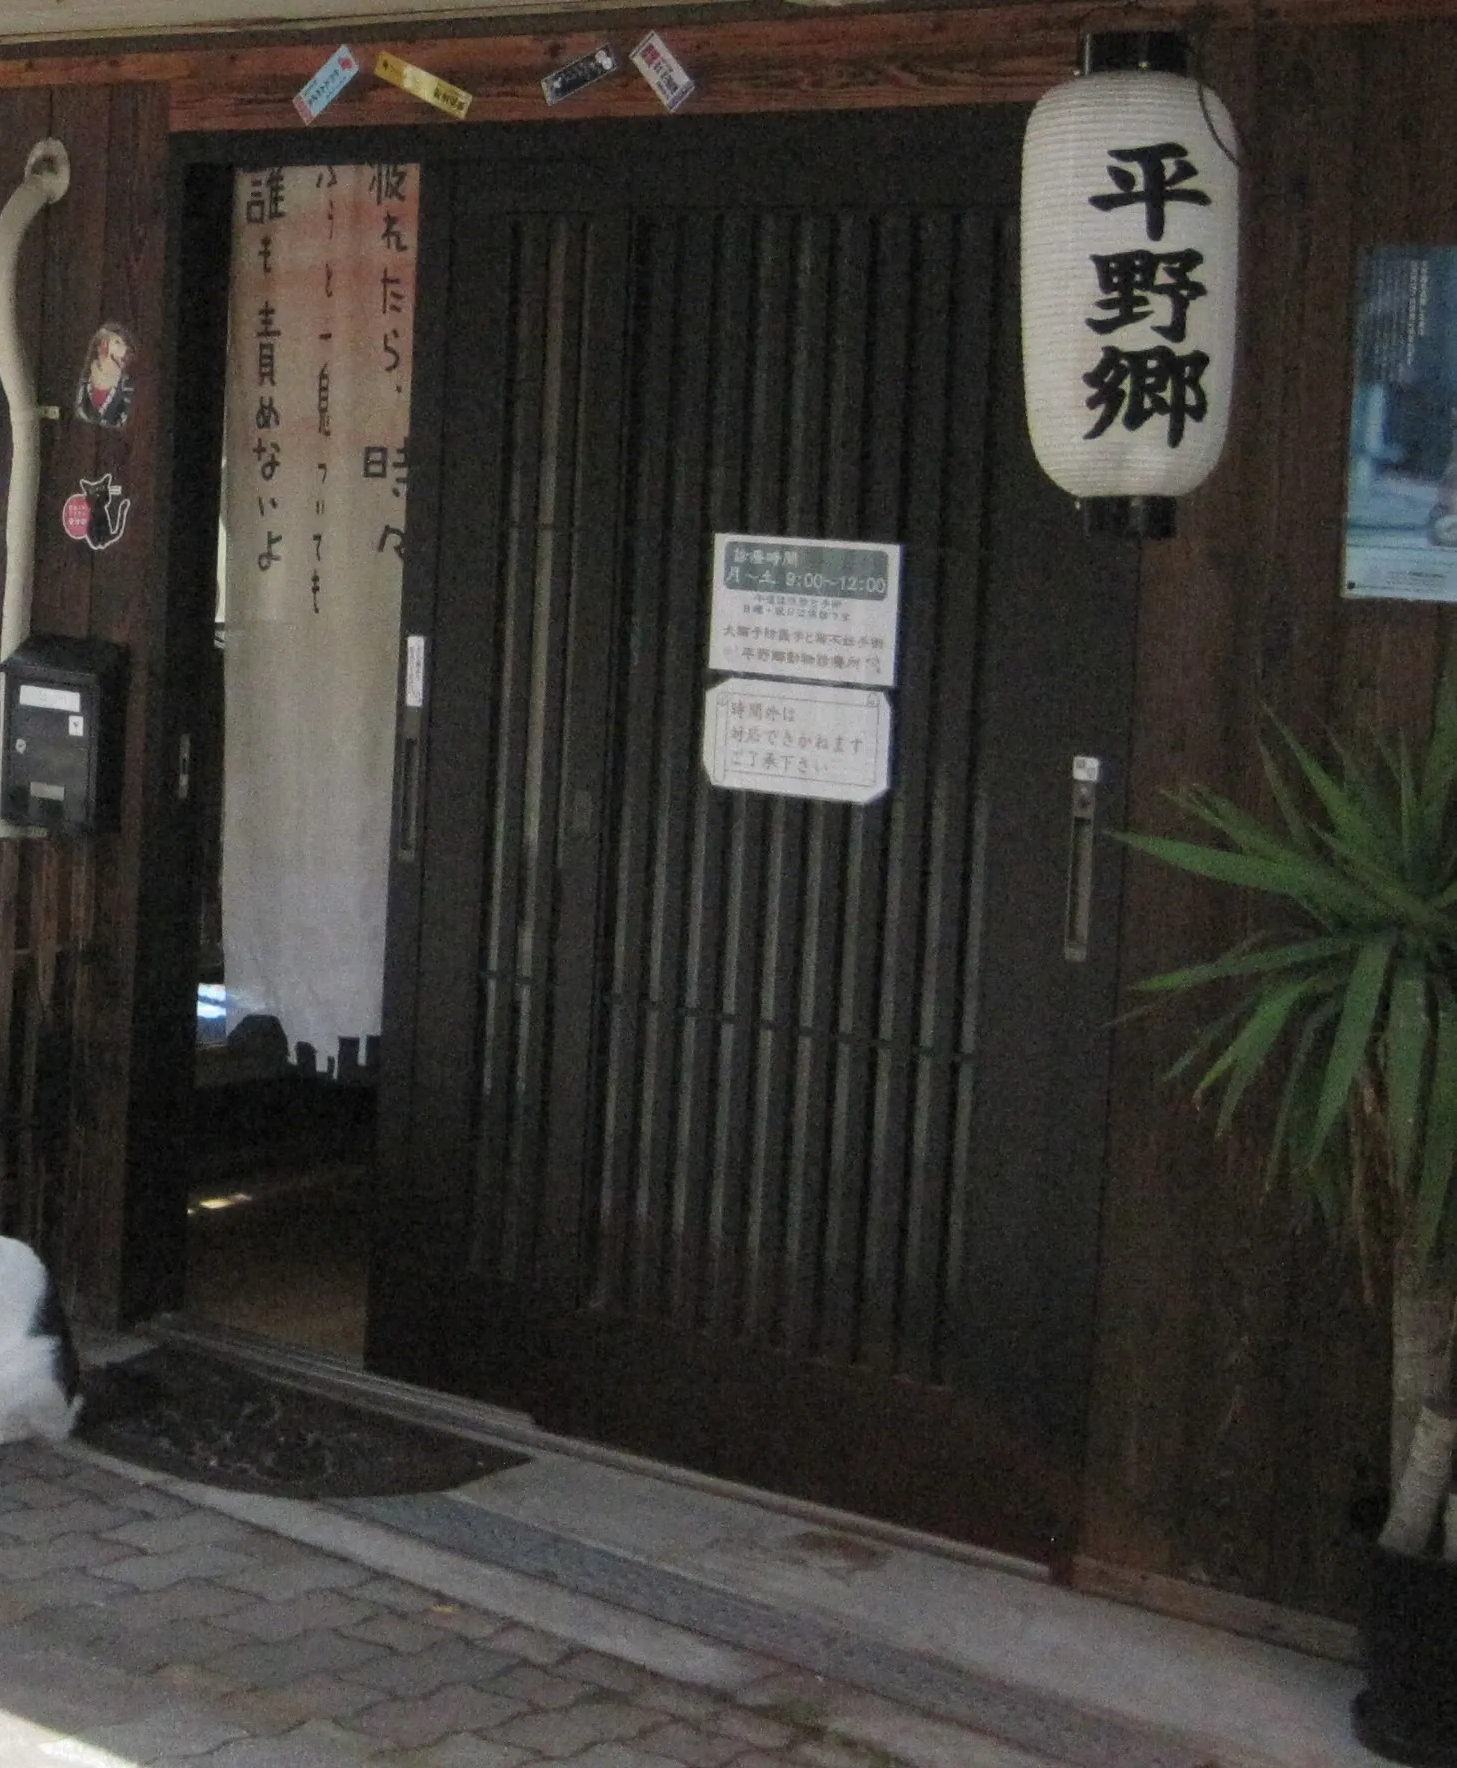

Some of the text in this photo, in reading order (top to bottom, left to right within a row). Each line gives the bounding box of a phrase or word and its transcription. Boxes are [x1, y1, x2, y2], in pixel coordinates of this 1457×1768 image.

[246, 171, 285, 570] 誰も責めないよ
[1082, 143, 1212, 448] 平野郷
[731, 727, 864, 754] 対応できかねます
